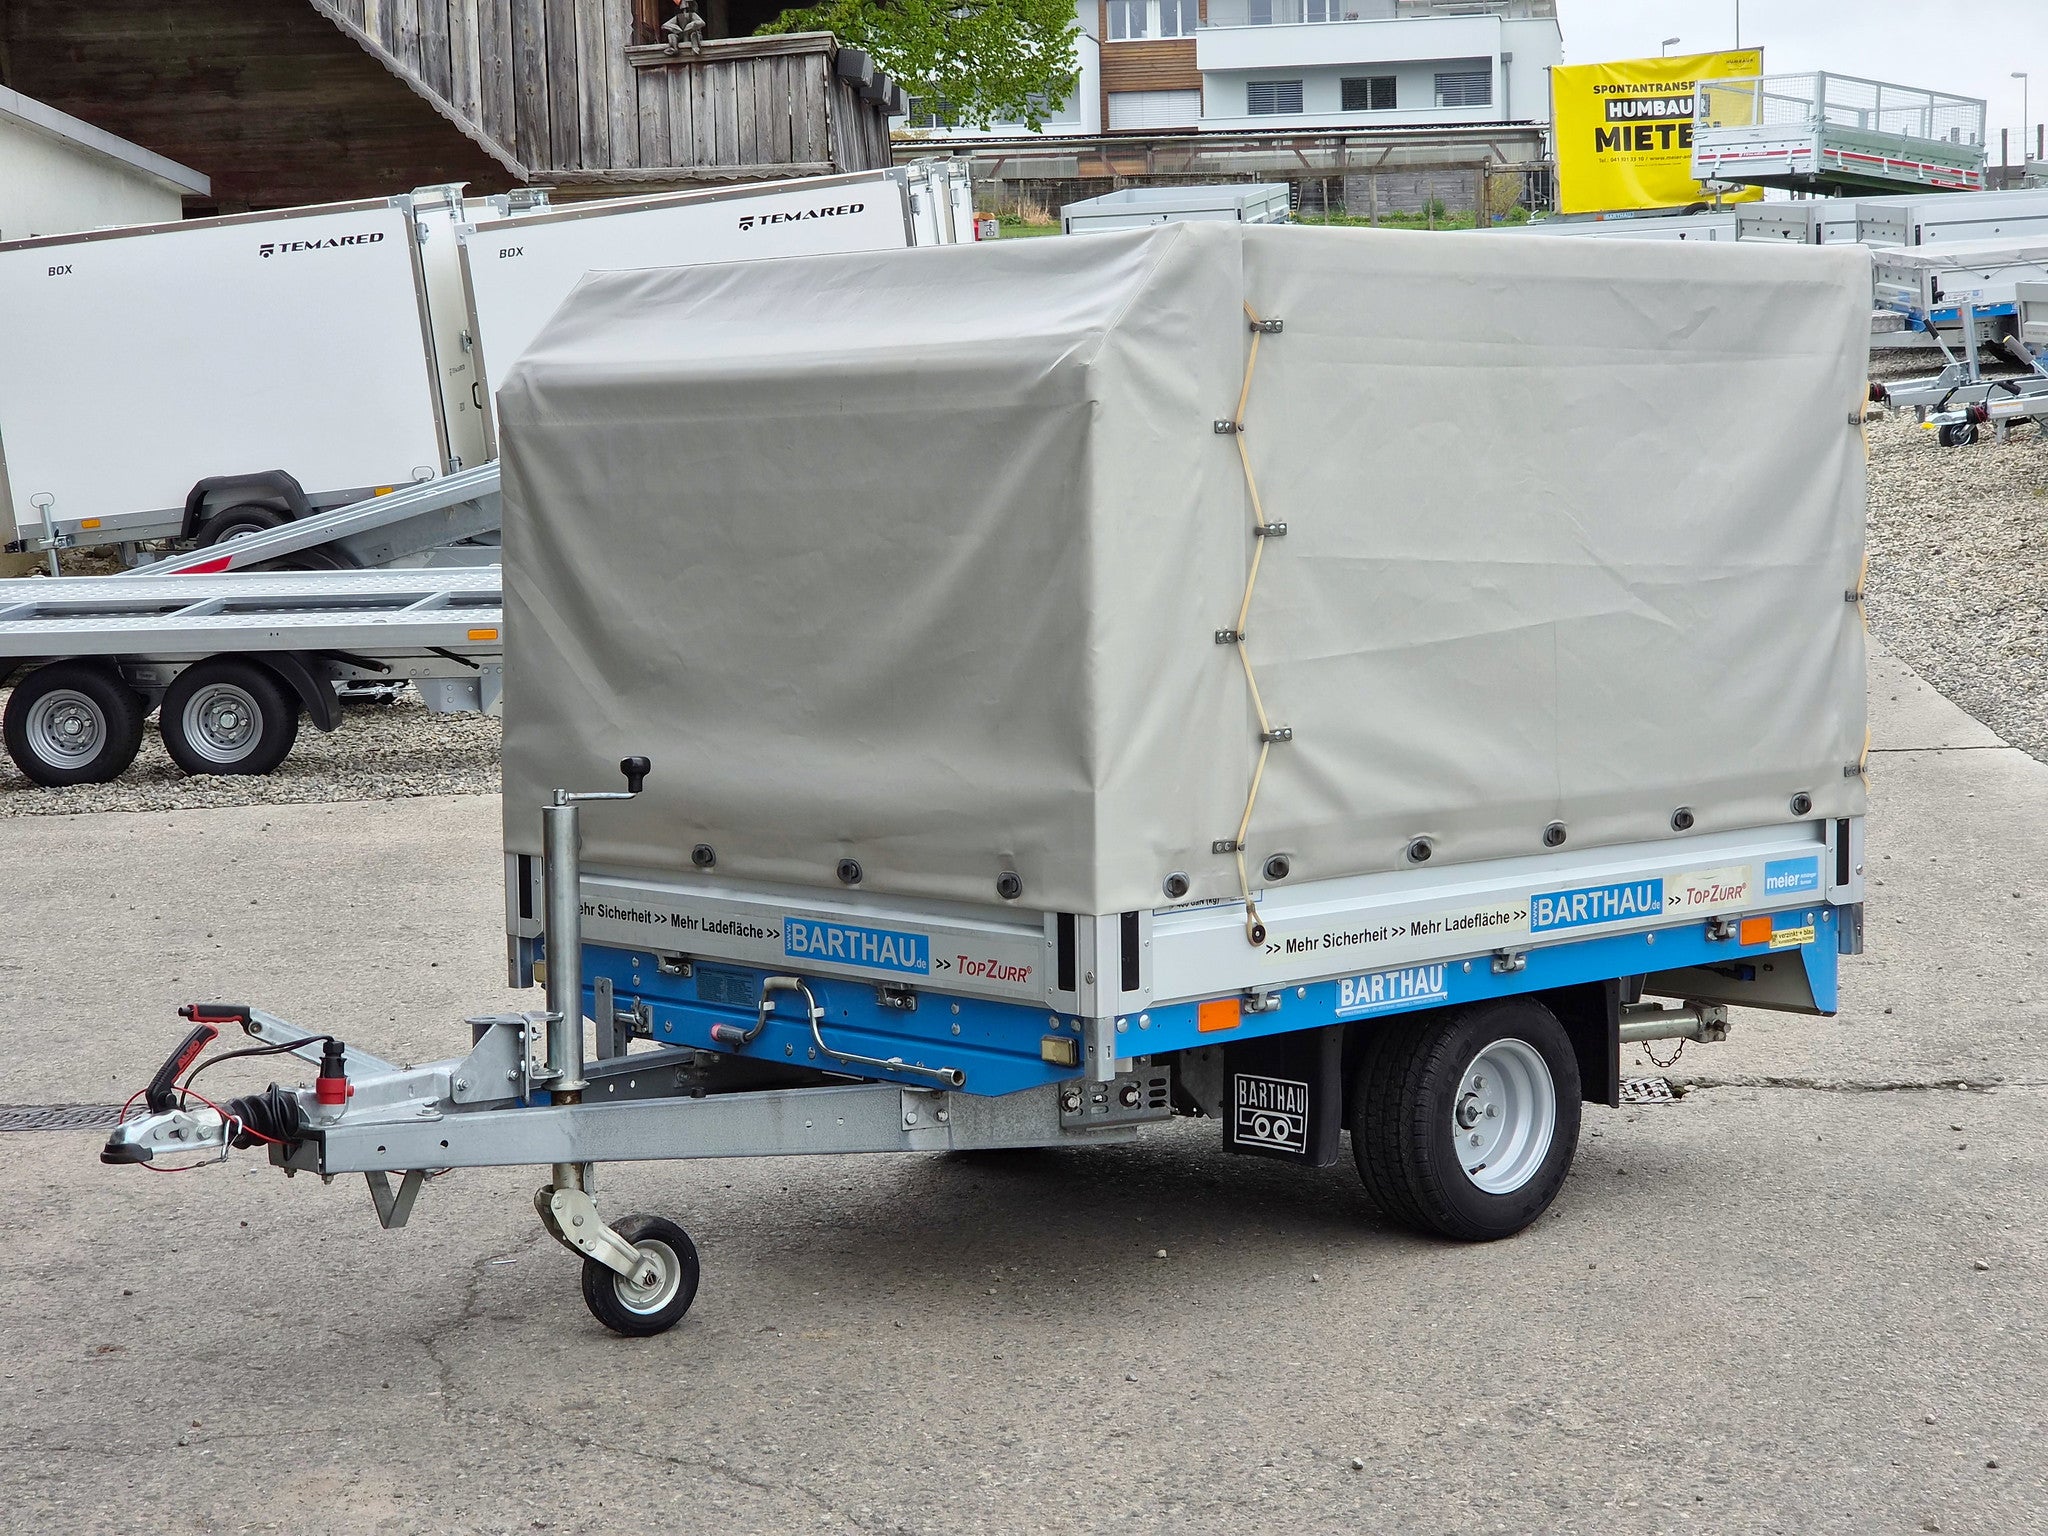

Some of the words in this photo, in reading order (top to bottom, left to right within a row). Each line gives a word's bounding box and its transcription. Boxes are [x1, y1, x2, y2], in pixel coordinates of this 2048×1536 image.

[1593, 81, 1695, 95] SPONTANTRANSP
[1595, 122, 1693, 153] MIETE
[758, 203, 864, 225] TEMARED
[279, 232, 384, 253] TEMARED
[499, 246, 523, 259] BOX
[48, 264, 72, 277] BOX
[1766, 872, 1799, 890] meier
[579, 901, 595, 916] ehr
[597, 903, 651, 924] Sicherheit
[671, 913, 699, 930] Mehr
[701, 917, 763, 939] Ladefläche
[1286, 936, 1319, 953] Mehr
[1322, 926, 1388, 949] Sicherheit
[1410, 919, 1441, 937] Mehr
[1445, 911, 1510, 932] Ladefläche
[1341, 965, 1443, 1007] BARTHAU
[1239, 1079, 1304, 1114] BARTHAU
